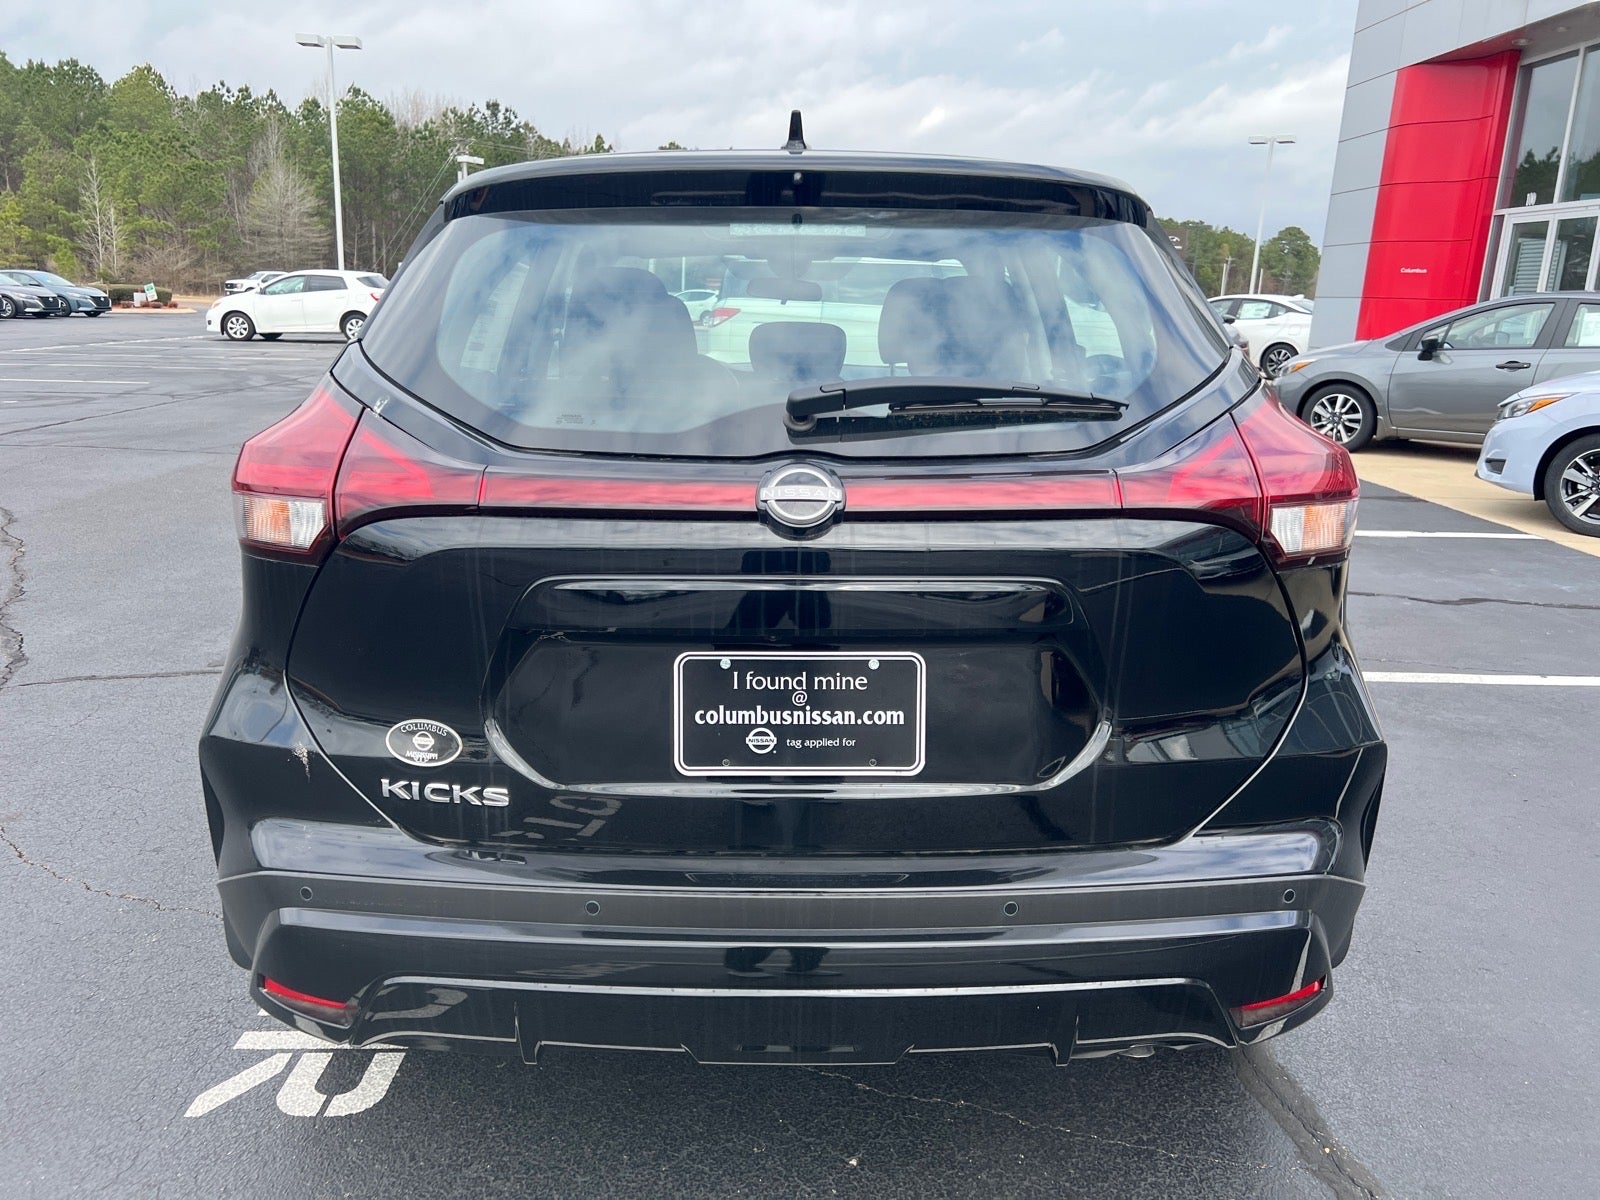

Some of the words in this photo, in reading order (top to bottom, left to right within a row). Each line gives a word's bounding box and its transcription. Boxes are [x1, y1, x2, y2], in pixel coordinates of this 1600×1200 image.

[762, 488, 840, 499] NISSAN
[732, 671, 739, 690] I
[745, 671, 807, 690] found
[814, 672, 868, 690] mine
[791, 690, 808, 707] @
[694, 705, 905, 725] columbusnissan.com
[400, 722, 448, 737] COLUMBUS
[786, 738, 802, 749] tag
[804, 737, 840, 749] applied
[842, 737, 856, 747] for
[380, 778, 510, 807] KICKS
